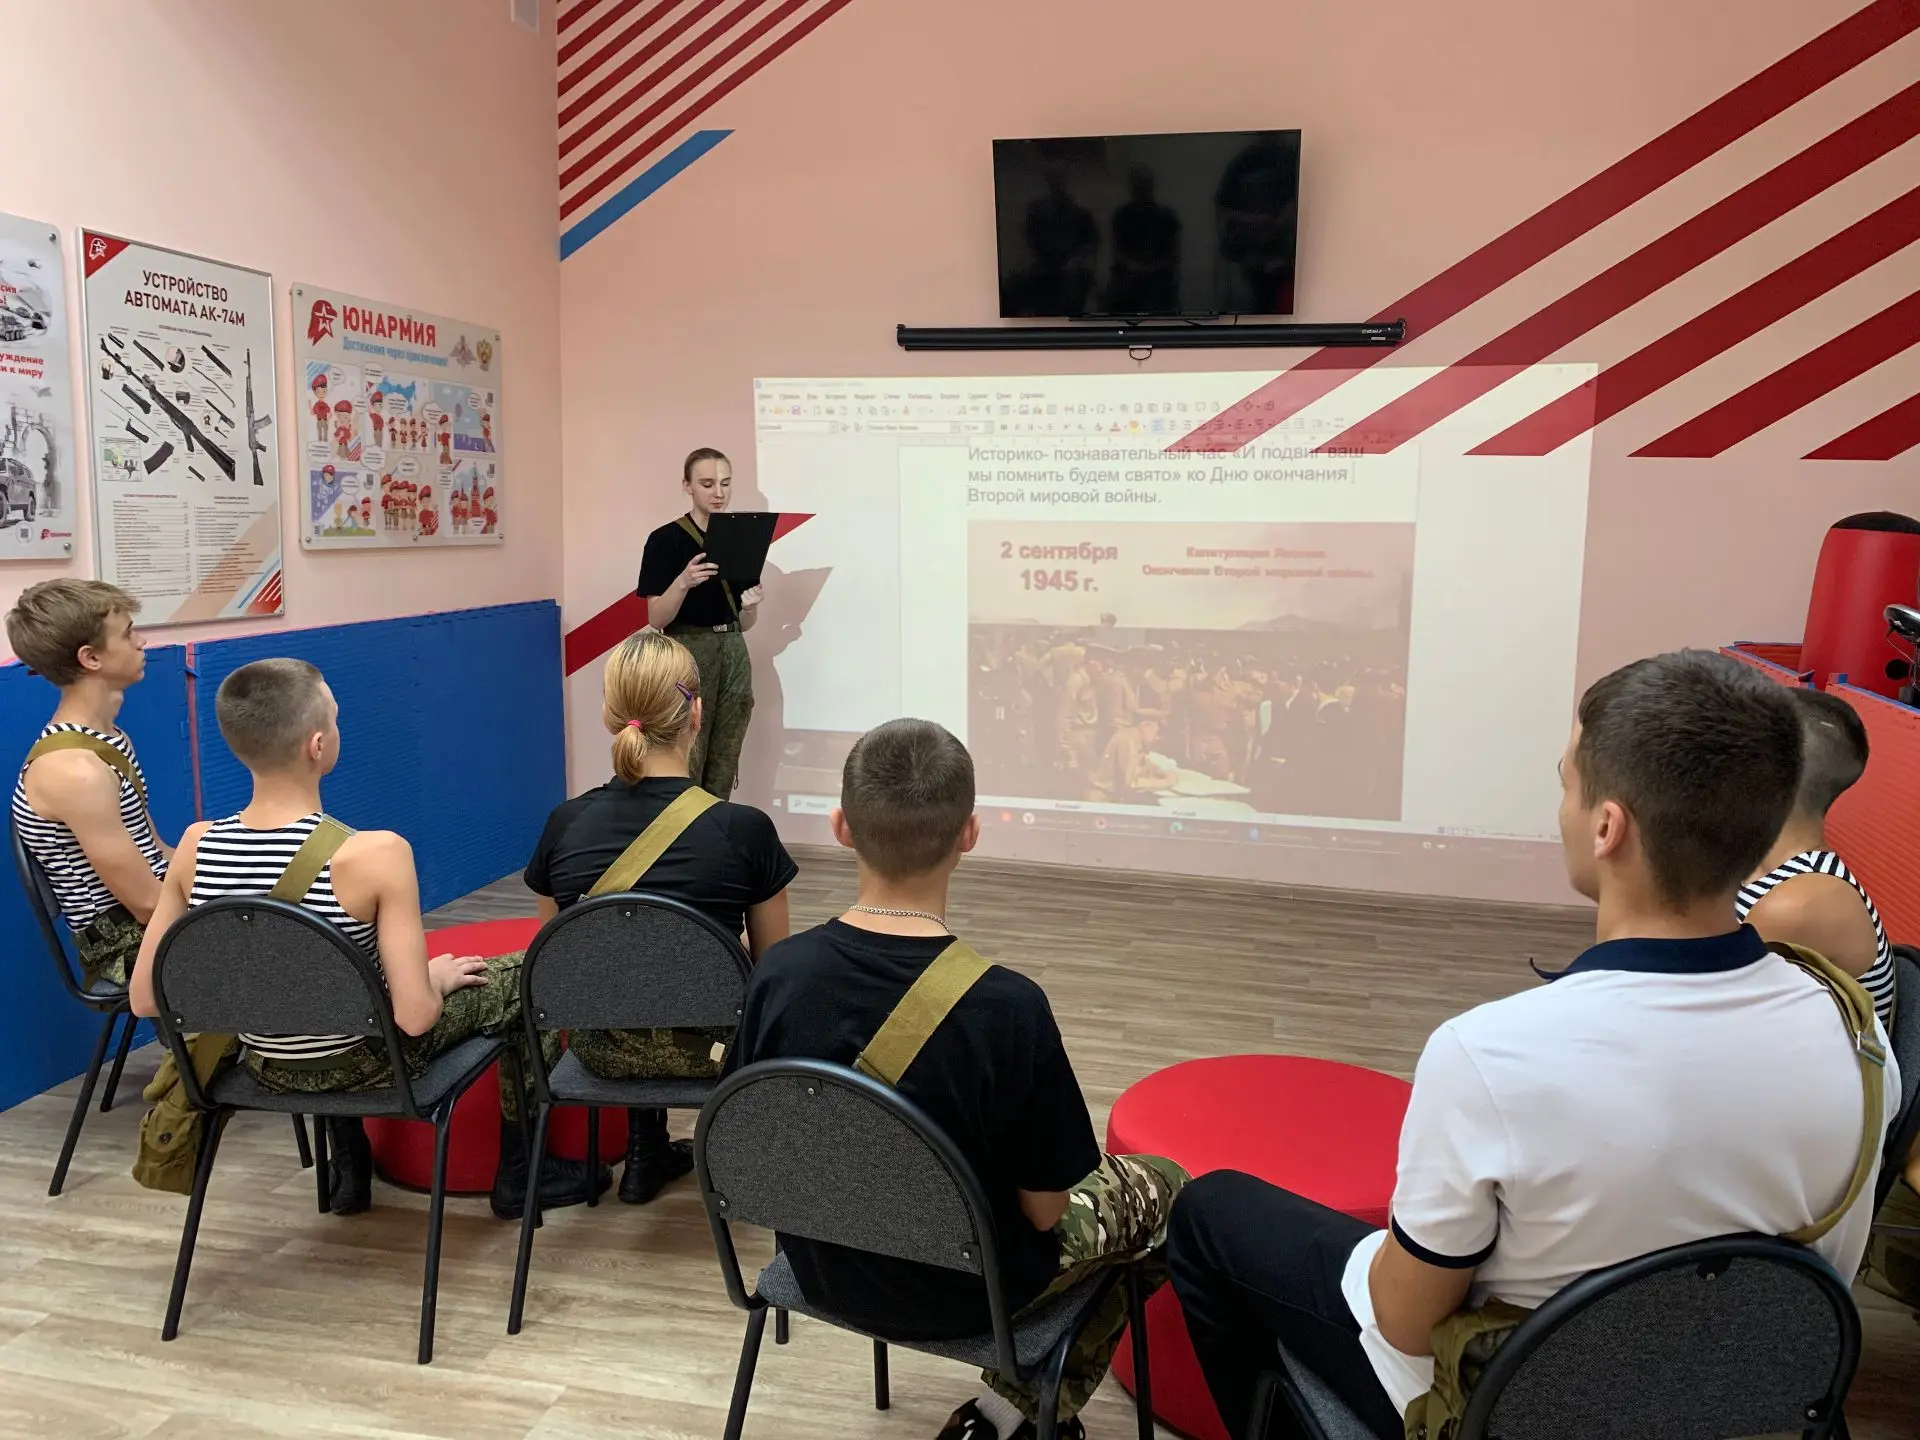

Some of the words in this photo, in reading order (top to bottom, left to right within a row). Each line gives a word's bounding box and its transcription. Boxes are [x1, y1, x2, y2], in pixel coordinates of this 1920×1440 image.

[143, 269, 228, 303] УСТРОЙСТВО
[124, 290, 198, 318] АВТОМАТА
[200, 304, 245, 327] АК-74М
[342, 304, 437, 348] ЮНАРМИЯ
[19, 367, 44, 379] миру
[968, 447, 1049, 464] Историко-
[1054, 445, 1192, 463] познавательный
[1196, 447, 1227, 460] час
[1261, 447, 1321, 462] подвиг
[1327, 446, 1365, 460] ваш
[968, 470, 992, 482] мы
[997, 469, 1064, 482] помнить
[1069, 466, 1120, 485] будем
[1125, 469, 1182, 482] свято»
[1187, 468, 1206, 482] ко
[1210, 466, 1249, 484] Дню
[1253, 467, 1348, 482] окончания
[968, 488, 1025, 504] Второй
[1031, 488, 1100, 505] мировой
[1105, 488, 1162, 504] войны.
[1000, 541, 1013, 559] 2
[1019, 541, 1118, 565] сентября
[1020, 568, 1079, 592] 1945
[1083, 577, 1099, 592] г.
